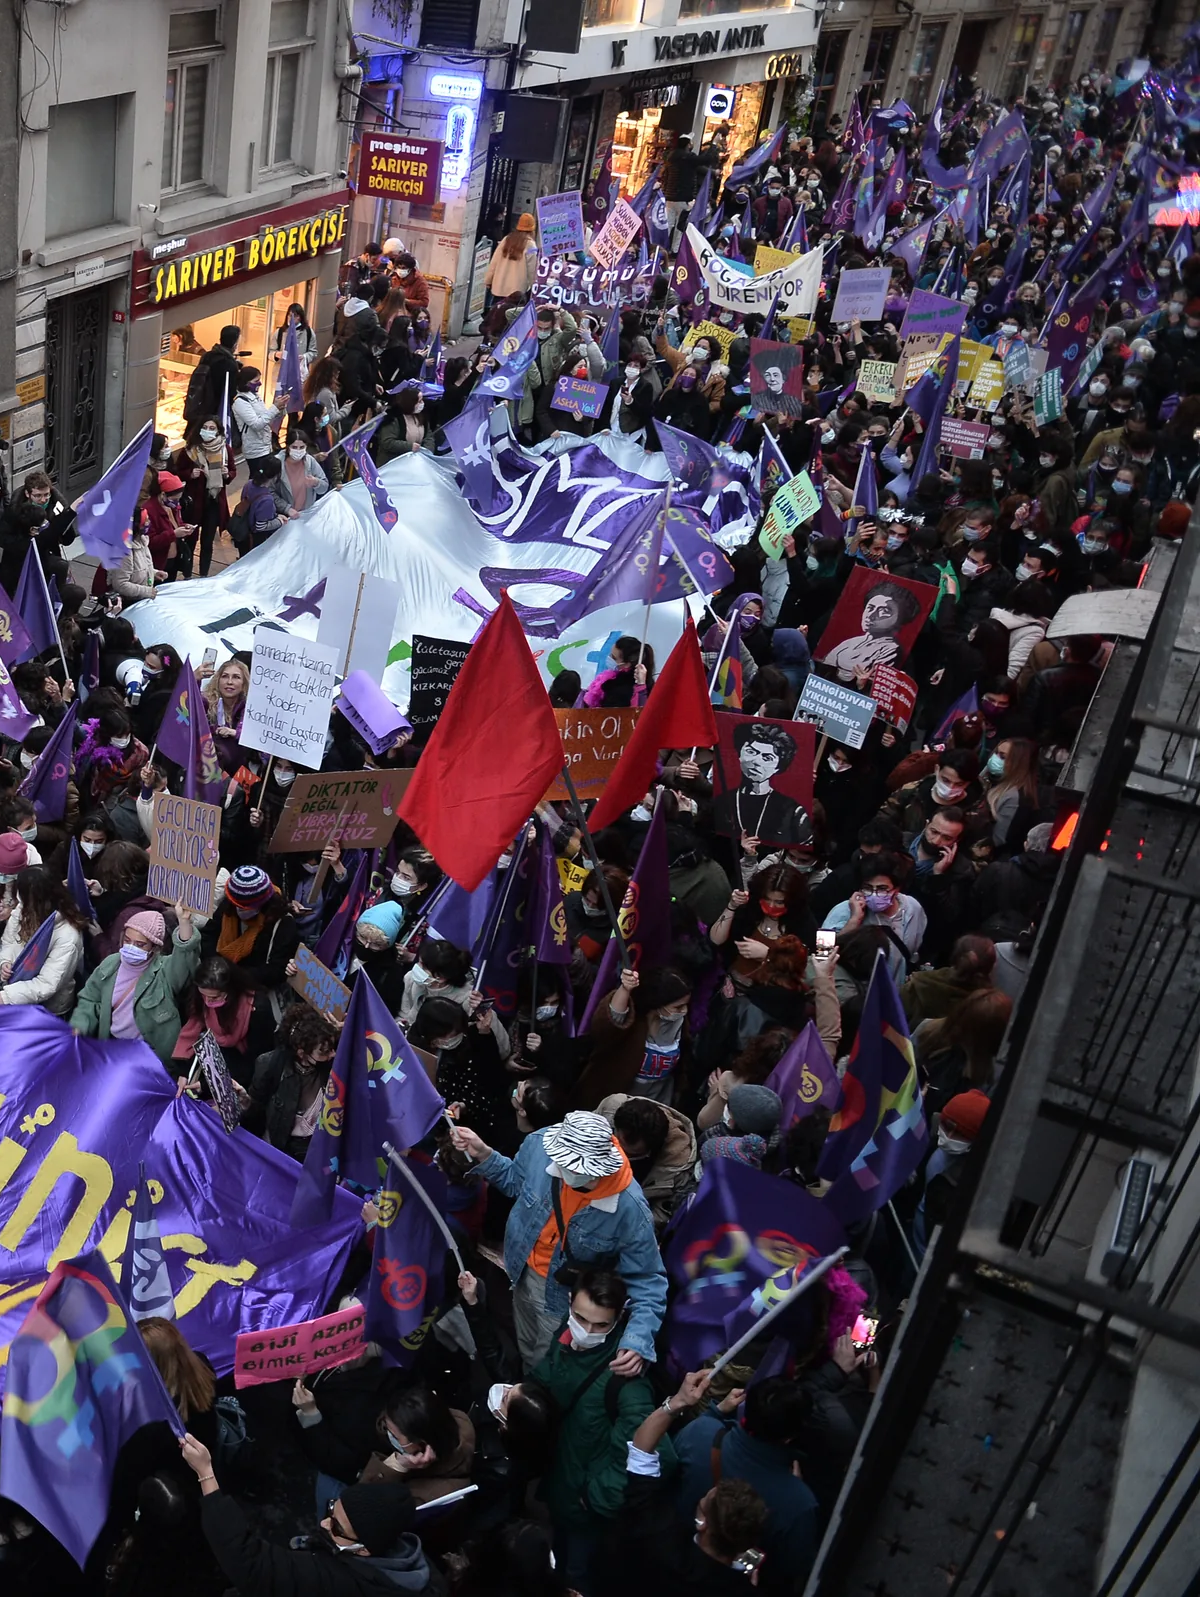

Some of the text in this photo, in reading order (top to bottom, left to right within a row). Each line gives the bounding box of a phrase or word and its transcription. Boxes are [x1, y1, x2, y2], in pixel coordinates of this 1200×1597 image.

[370, 155, 428, 178] SARIYER
[152, 236, 187, 259] meşhur
[155, 206, 345, 302] SARIYER BÖREKÇİSİ
[255, 663, 333, 700] geçer dedikleri
[804, 688, 849, 714] YIKILMAZ
[807, 678, 874, 712] HANGİ DUVAR
[307, 778, 379, 799] DİKTATÖR
